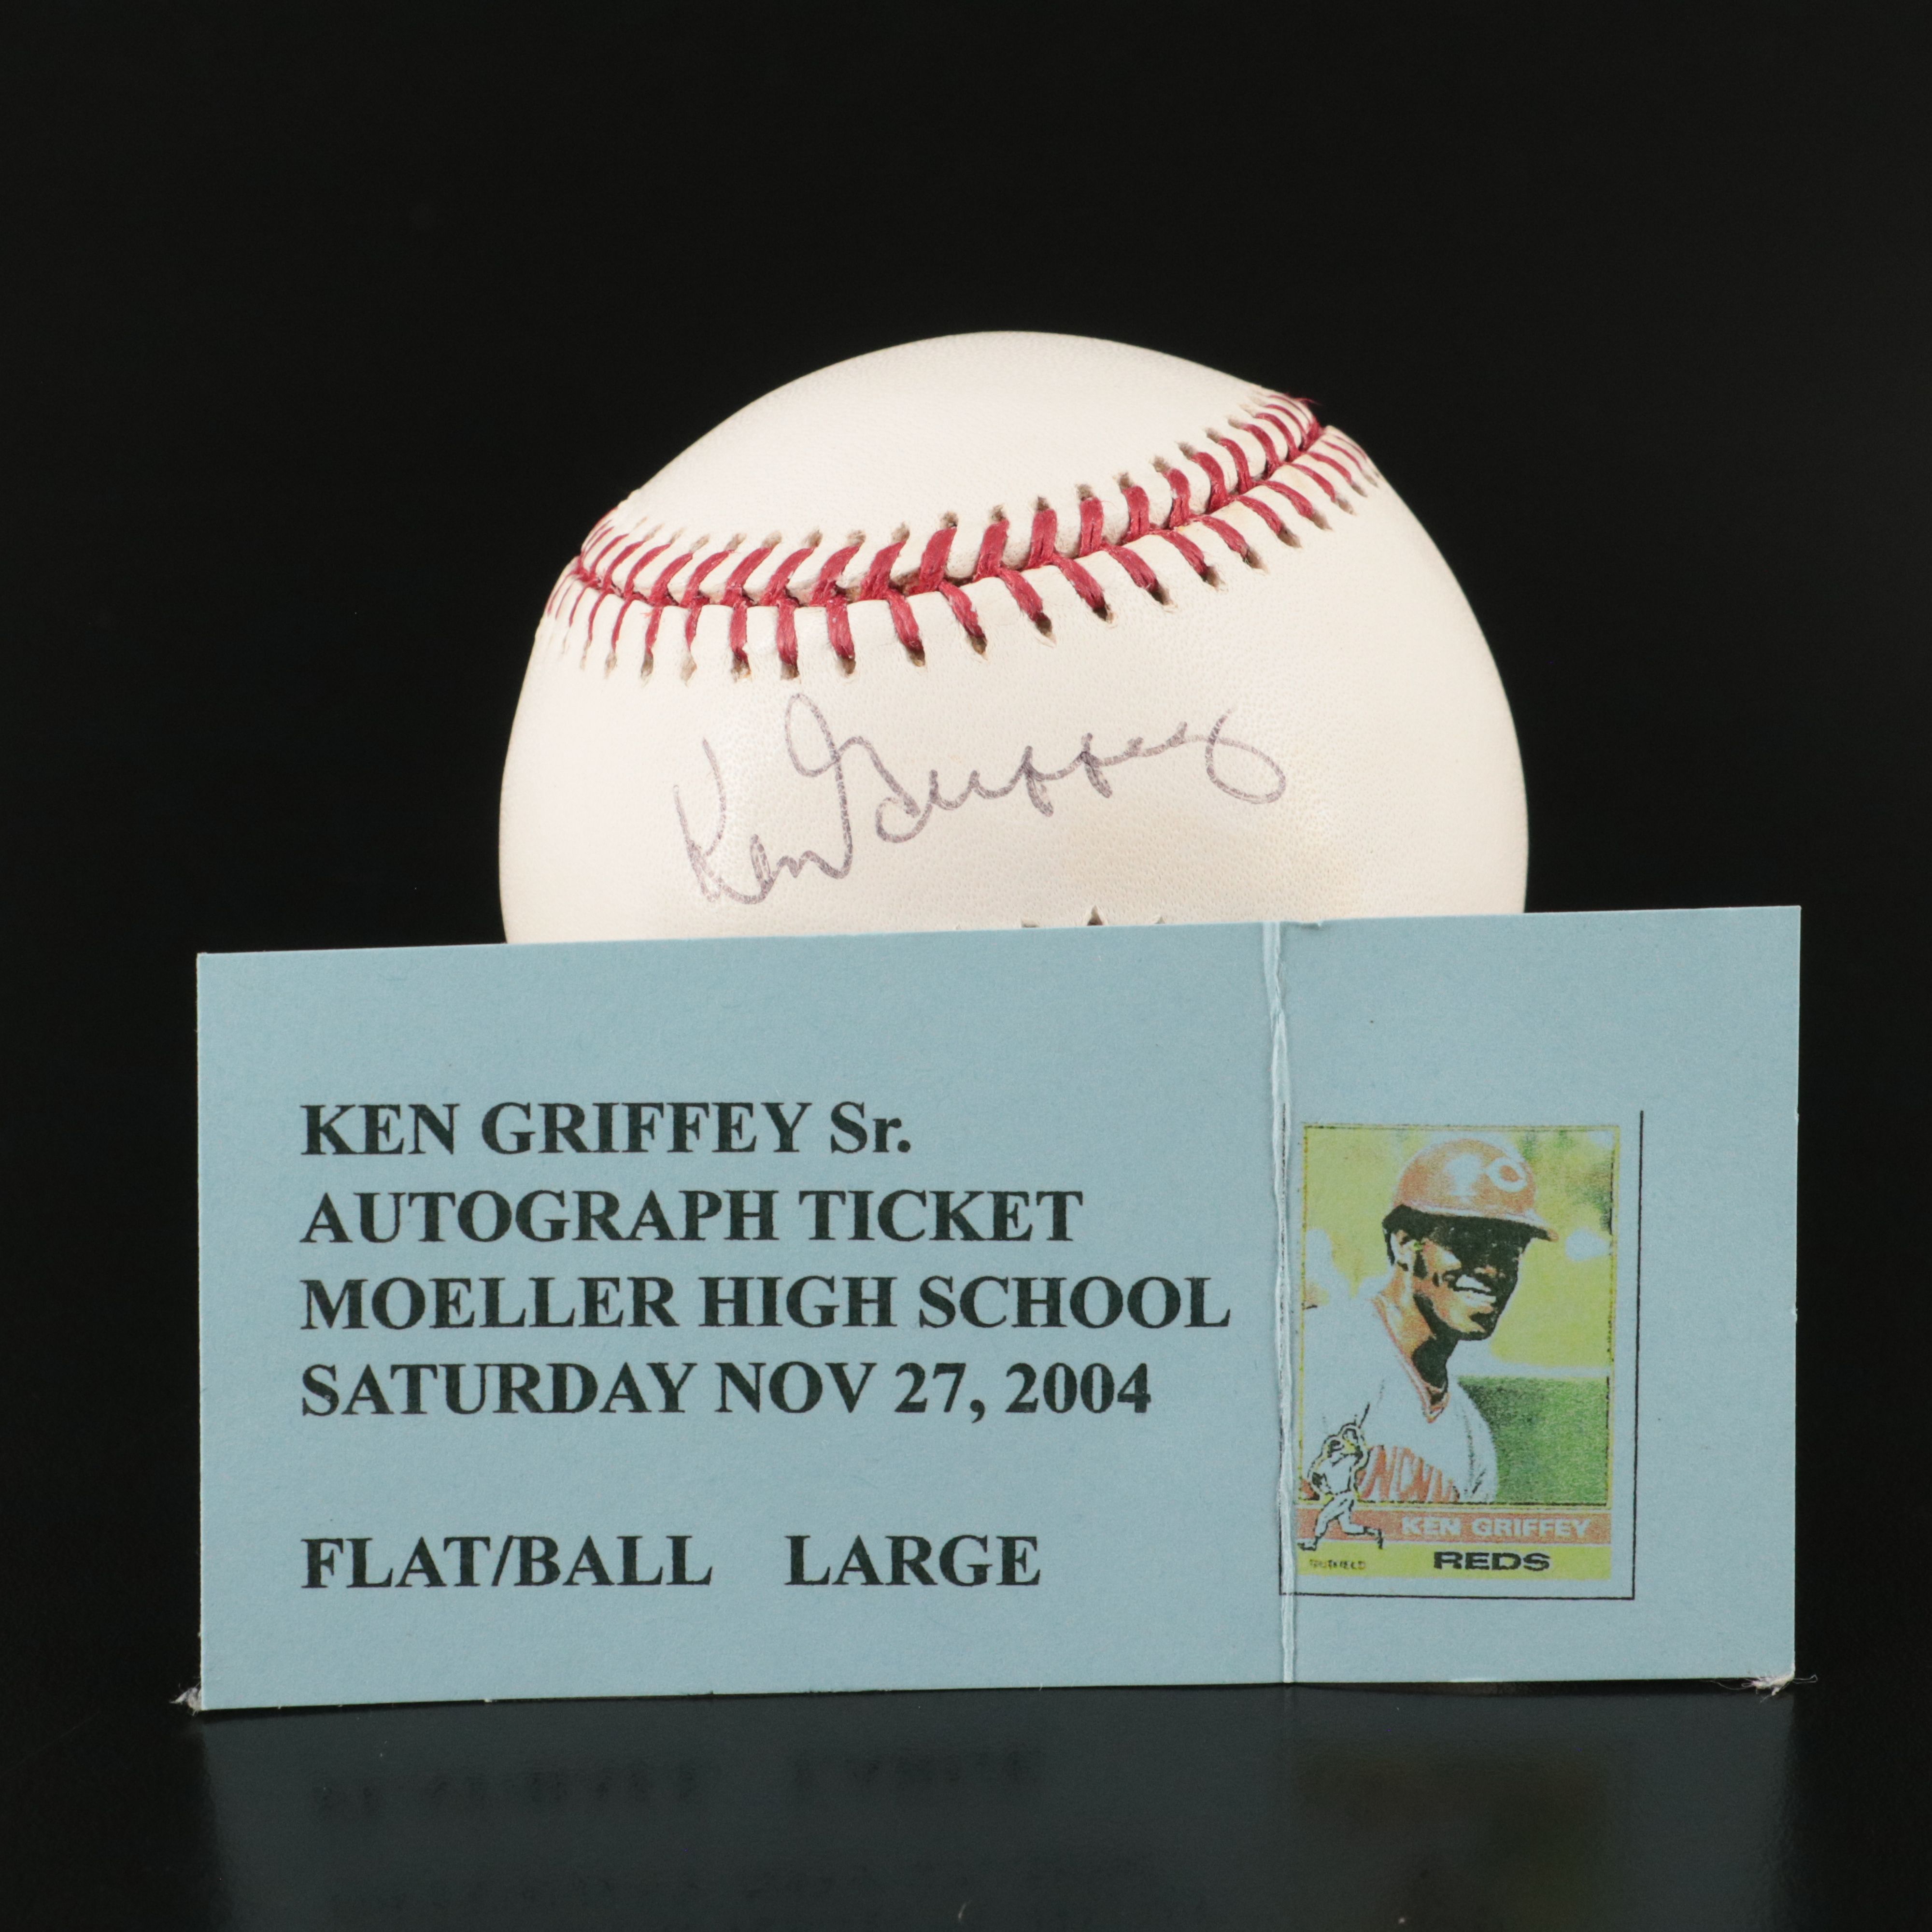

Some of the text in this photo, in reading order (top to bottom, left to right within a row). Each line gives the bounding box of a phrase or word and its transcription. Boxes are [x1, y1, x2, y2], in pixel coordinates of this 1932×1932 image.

[673, 738, 853, 905] Ken
[300, 1101, 911, 1155] KEN GRIFFEY Sr.
[299, 1189, 1083, 1243] AUTOGRAPH TICKET
[300, 1275, 1231, 1330] MOELLER HIGH SCHOOL
[302, 1361, 1151, 1423] SATURDAY NOV 27, 2004
[1402, 1516, 1591, 1537] KEN GRIFFEY
[301, 1534, 1040, 1589] FLAT/BALL LARGE
[1434, 1551, 1550, 1572] REDS
